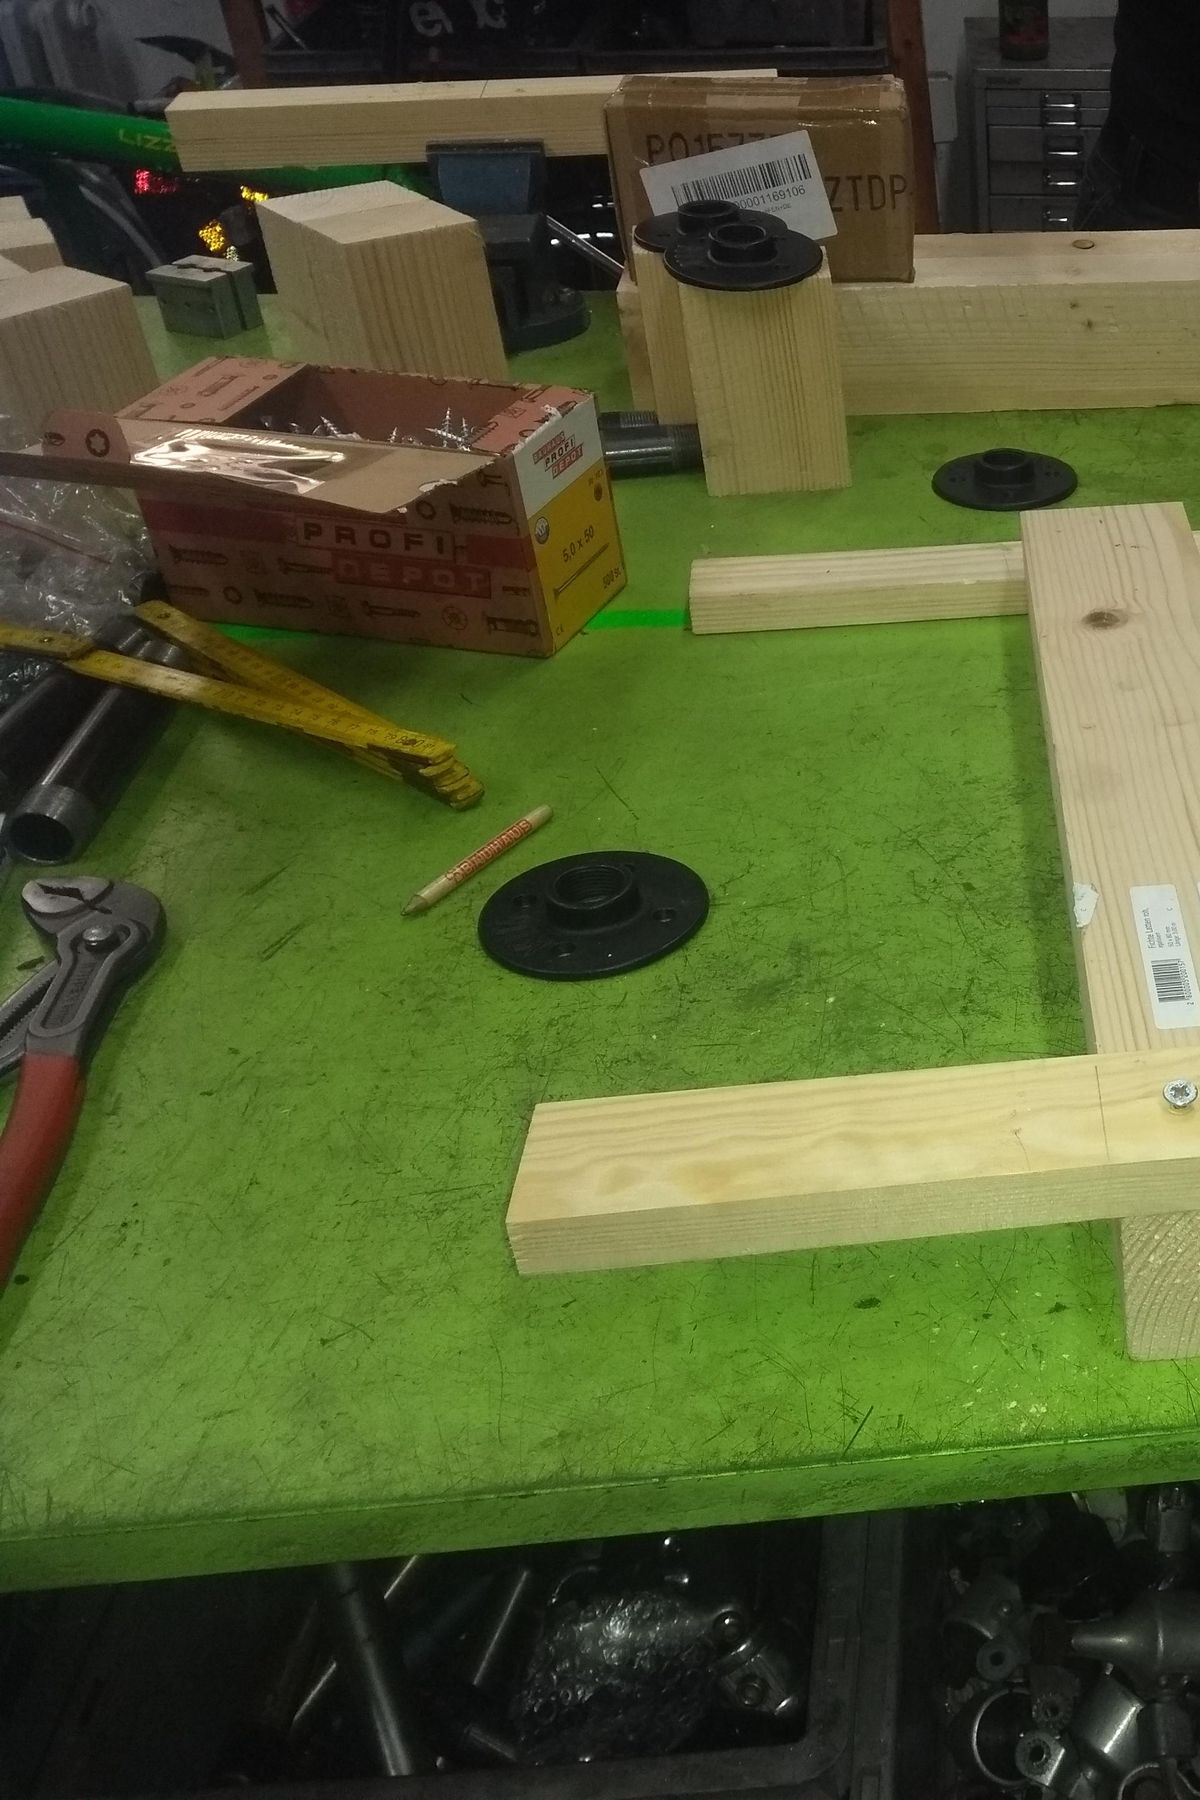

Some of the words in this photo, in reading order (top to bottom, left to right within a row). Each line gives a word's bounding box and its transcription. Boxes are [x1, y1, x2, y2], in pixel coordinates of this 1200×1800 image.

[545, 438, 575, 467] PROFI
[552, 445, 584, 478] DEPOT
[303, 522, 445, 554] PROFI
[337, 556, 485, 591] DEPOT
[461, 819, 531, 875] BAUHAUS
